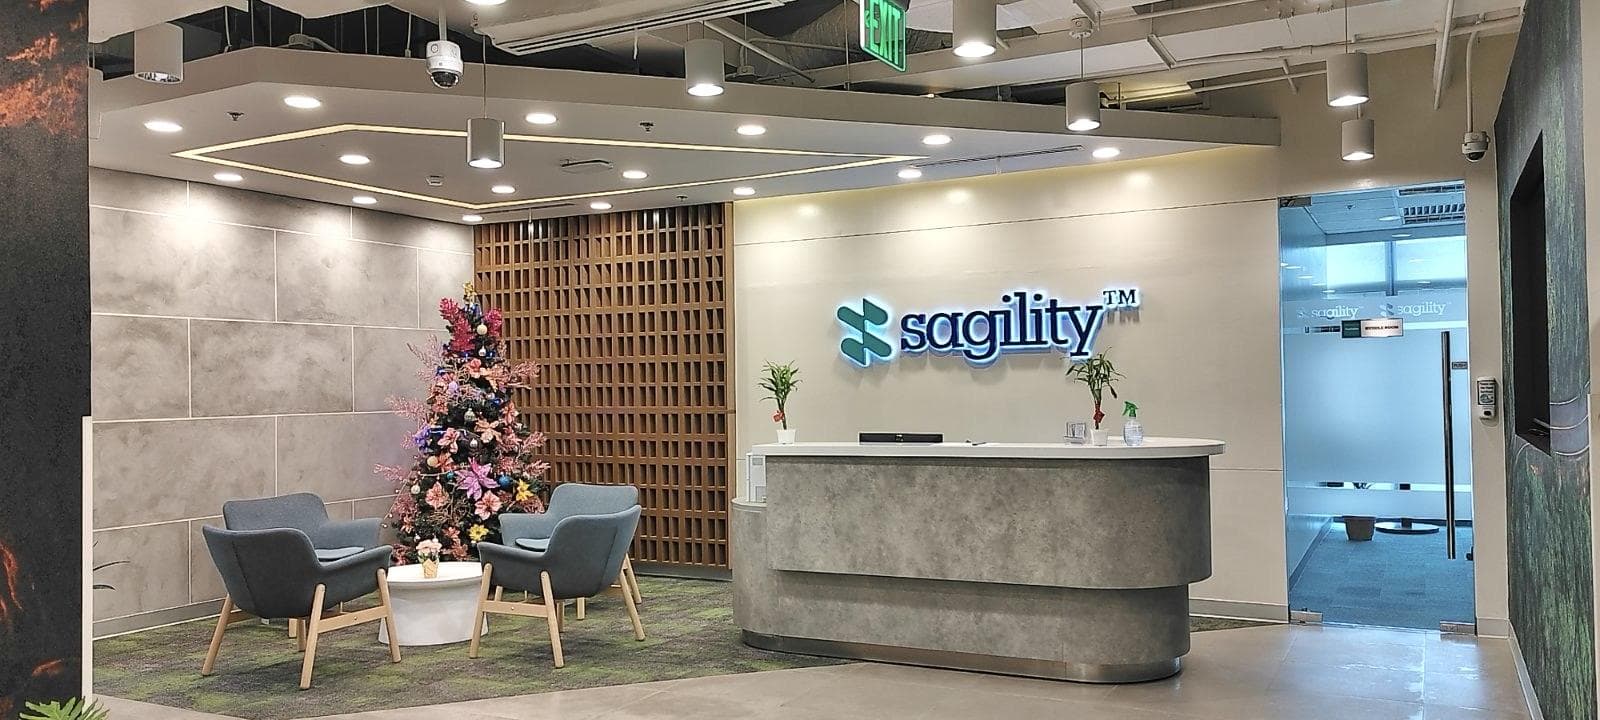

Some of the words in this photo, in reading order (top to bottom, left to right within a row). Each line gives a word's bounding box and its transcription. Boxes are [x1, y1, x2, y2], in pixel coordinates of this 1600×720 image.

[870, 0, 901, 65] EXIT
[900, 291, 1103, 360] sagility
[1311, 305, 1359, 319] sagility
[1397, 301, 1446, 317] sagility
